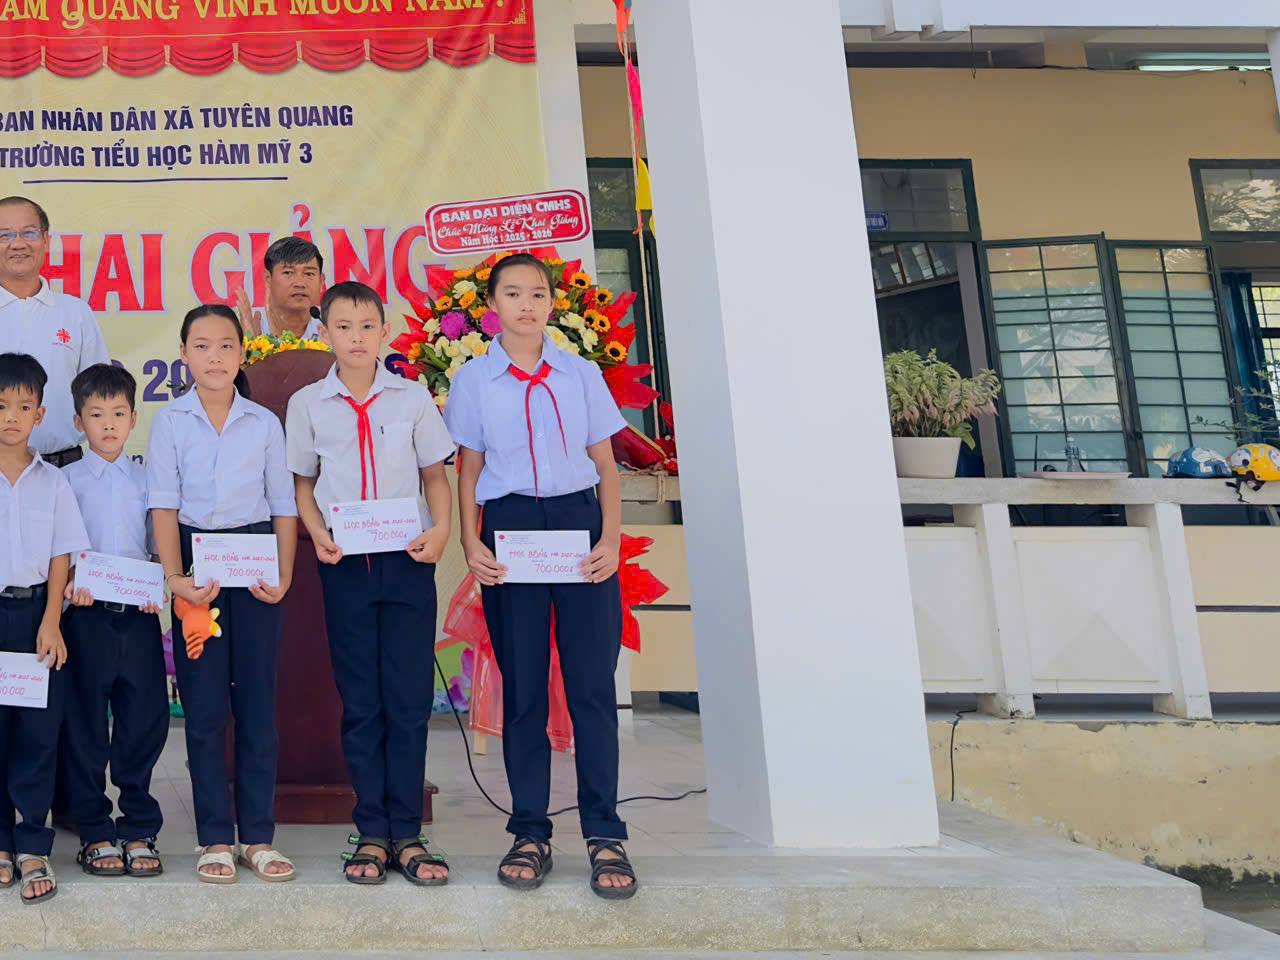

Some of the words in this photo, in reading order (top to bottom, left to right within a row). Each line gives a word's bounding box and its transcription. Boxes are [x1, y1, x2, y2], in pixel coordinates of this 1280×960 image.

[41, 107, 103, 132] NHÂN
[112, 106, 157, 131] DÂN
[164, 105, 194, 130] XÃ
[200, 103, 272, 129] TUYÊN
[278, 104, 353, 129] QUANG
[91, 138, 140, 167] TIỂU
[147, 144, 192, 171] HỌC
[200, 139, 250, 165] HÀM
[257, 139, 292, 164] MỸ
[298, 143, 313, 164] 3
[441, 209, 470, 223] BAN
[501, 202, 532, 217] DIỆN
[536, 199, 571, 212] CMHS
[505, 232, 526, 242] 2025
[143, 359, 195, 401] 20
